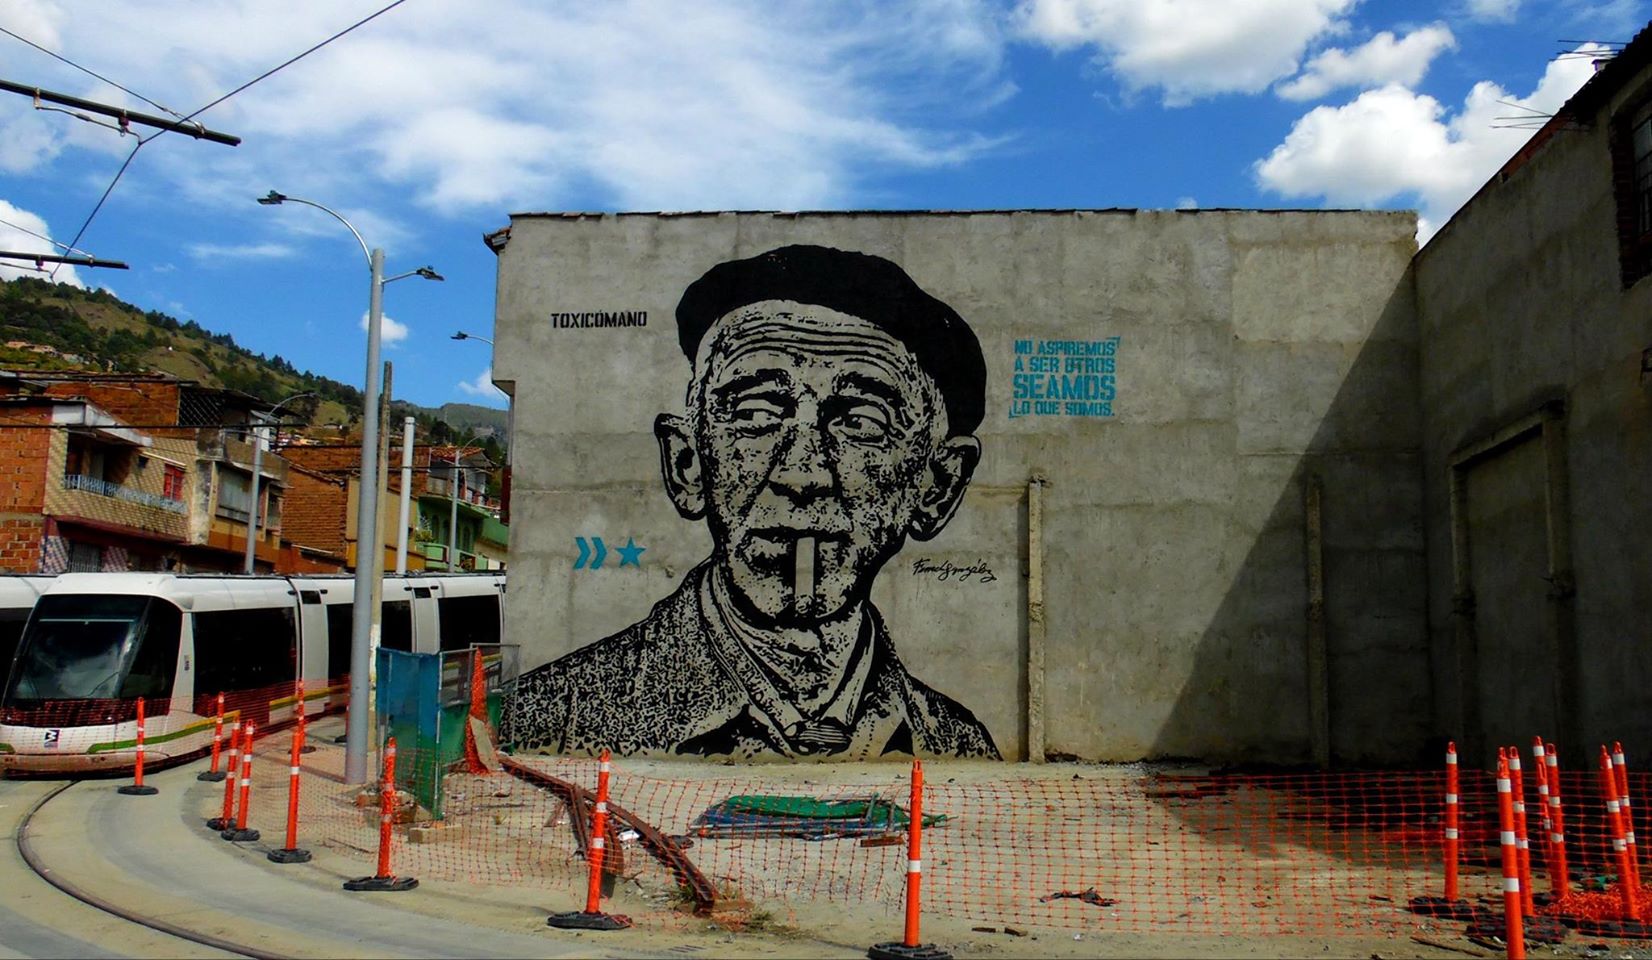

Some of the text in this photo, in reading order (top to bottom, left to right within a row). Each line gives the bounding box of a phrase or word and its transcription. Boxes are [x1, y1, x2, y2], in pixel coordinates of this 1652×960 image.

[1014, 340, 1116, 356] NO ASPIREMOS
[1015, 356, 1115, 373] A SER OTROS
[1013, 373, 1115, 401] SEAMOS
[1013, 400, 1031, 415] LO
[1035, 400, 1060, 416] QUE
